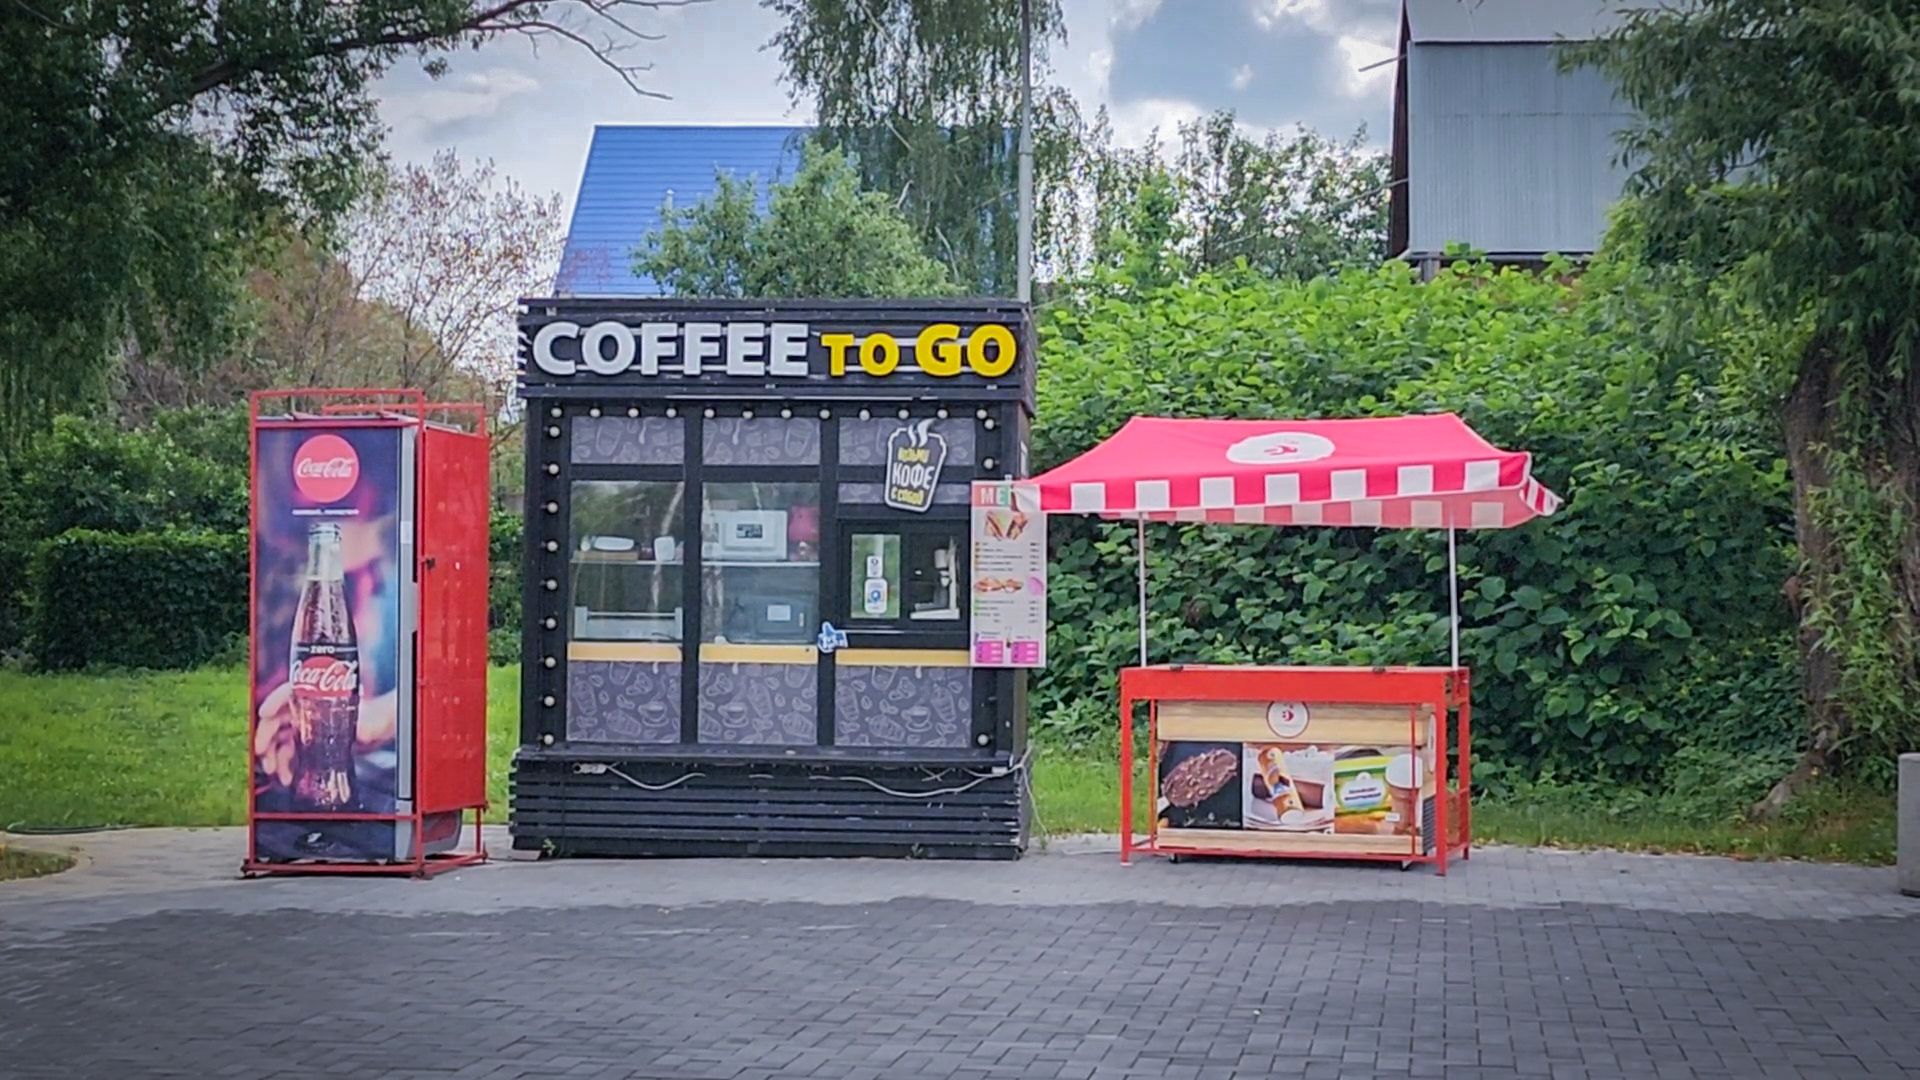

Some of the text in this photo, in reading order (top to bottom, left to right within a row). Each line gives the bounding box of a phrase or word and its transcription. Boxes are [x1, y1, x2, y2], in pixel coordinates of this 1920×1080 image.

[532, 320, 1017, 377] COFFEE TO GO
[297, 457, 354, 478] Coca-Cola
[892, 462, 935, 490] КОФЕ
[980, 487, 1006, 505] МЕ
[291, 660, 358, 692] Coca-Cola
